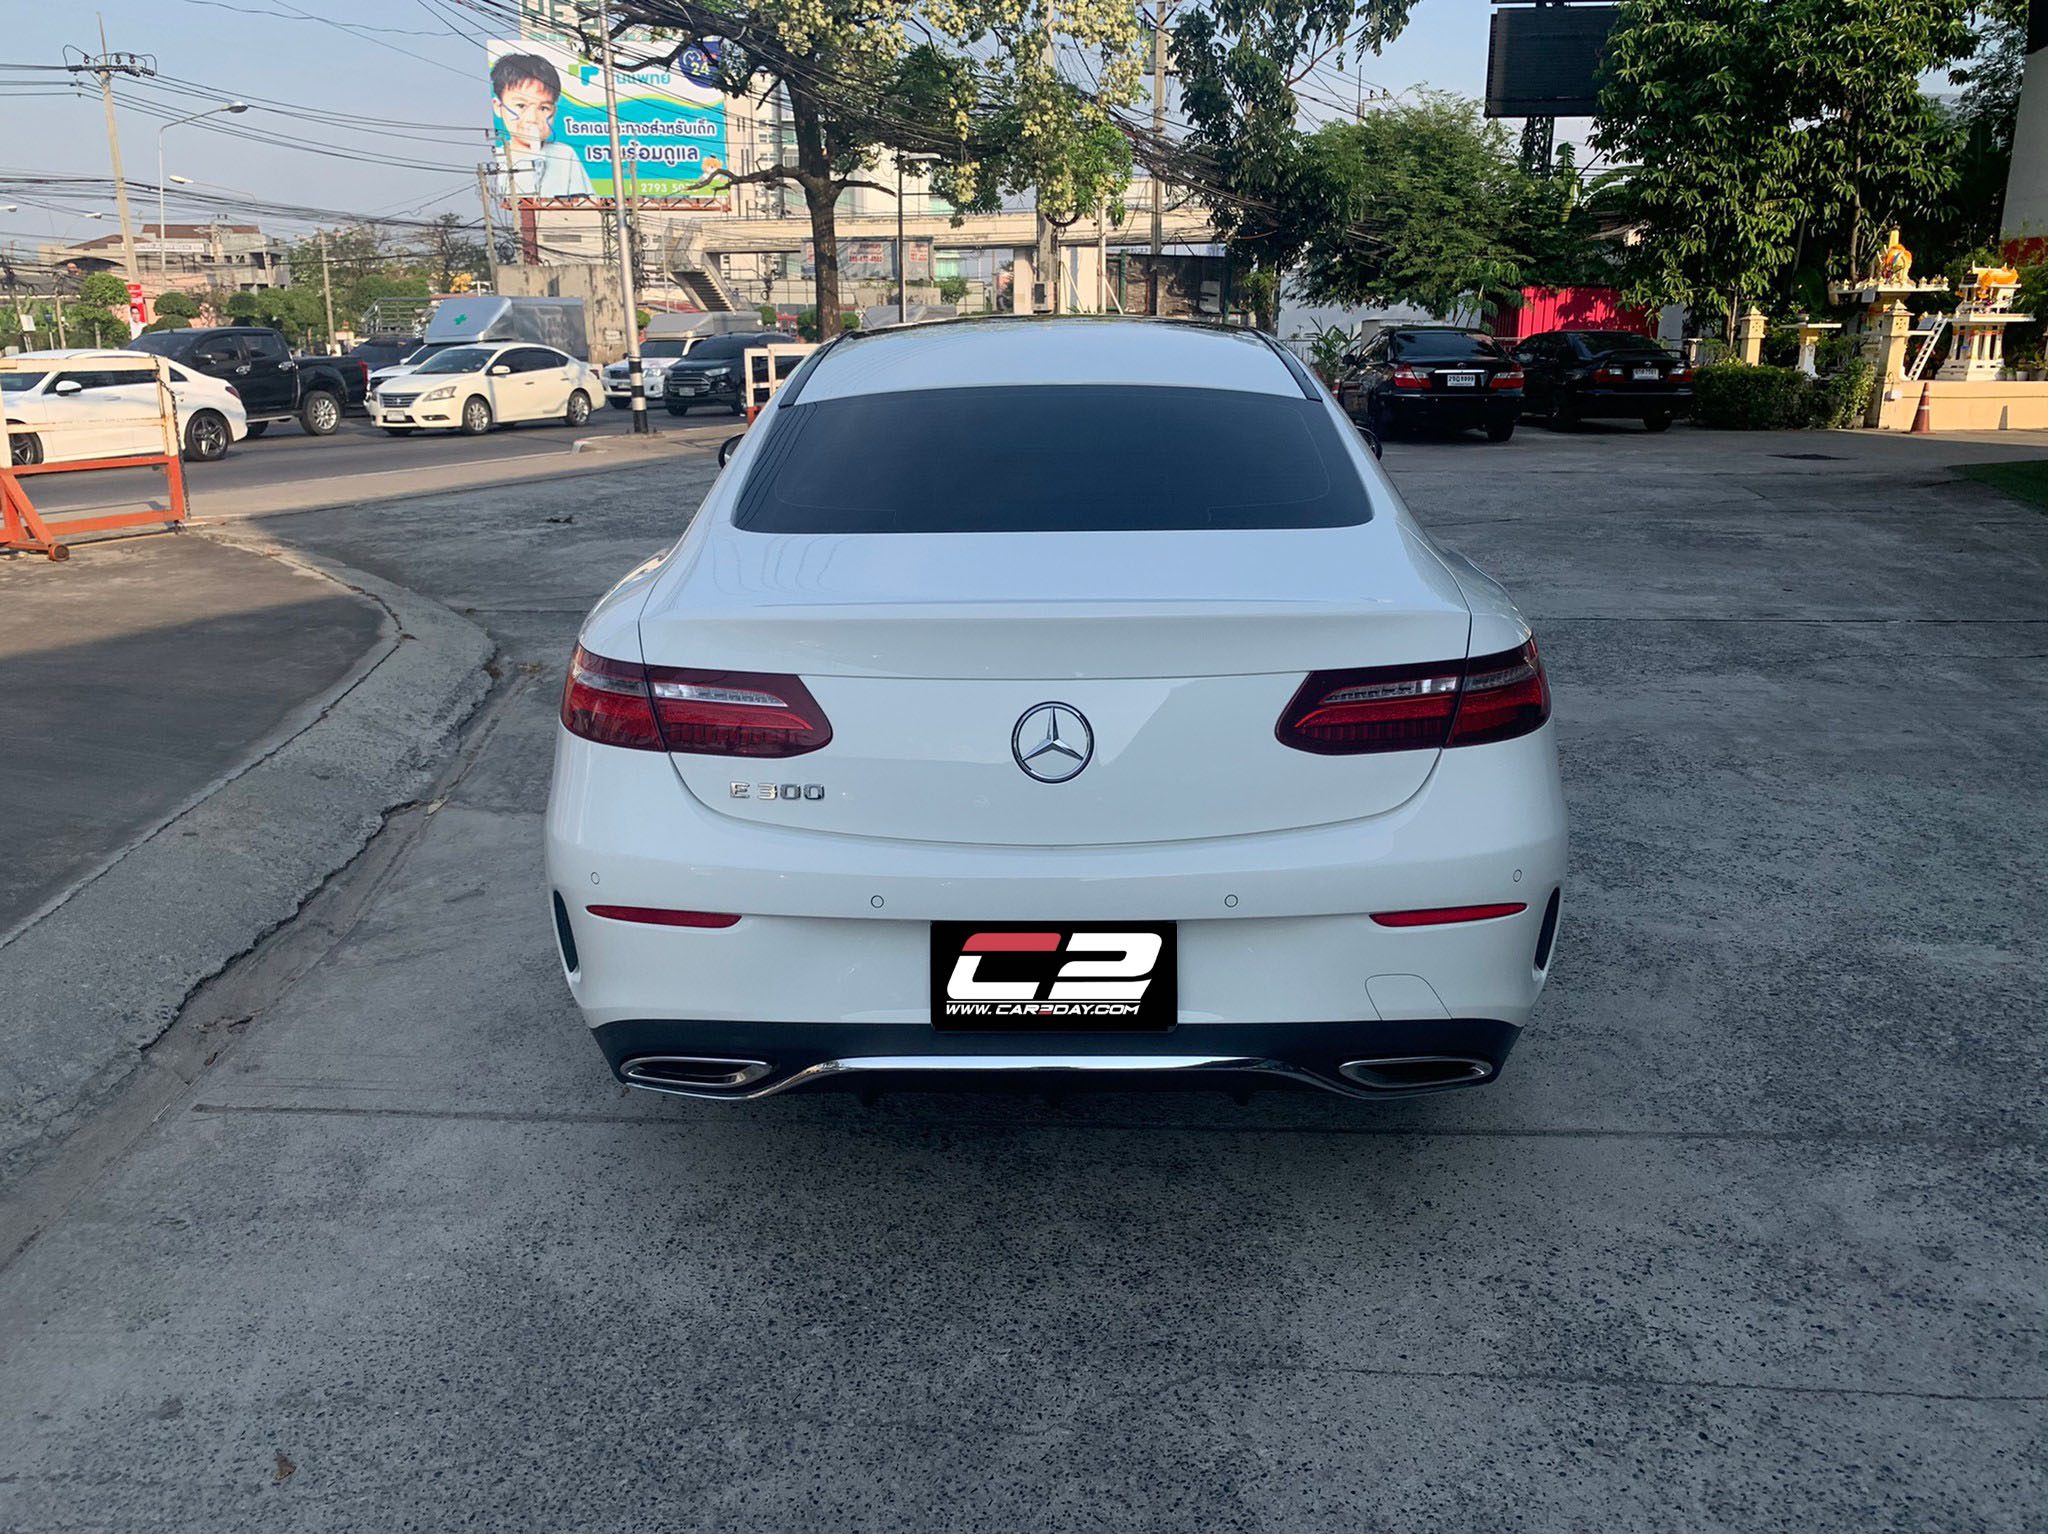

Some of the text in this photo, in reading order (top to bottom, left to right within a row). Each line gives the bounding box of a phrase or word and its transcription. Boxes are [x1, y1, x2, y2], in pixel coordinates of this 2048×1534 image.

[586, 141, 699, 165] เราร้อมดูแล
[640, 182, 668, 193] 2793
[729, 781, 825, 801] E 300
